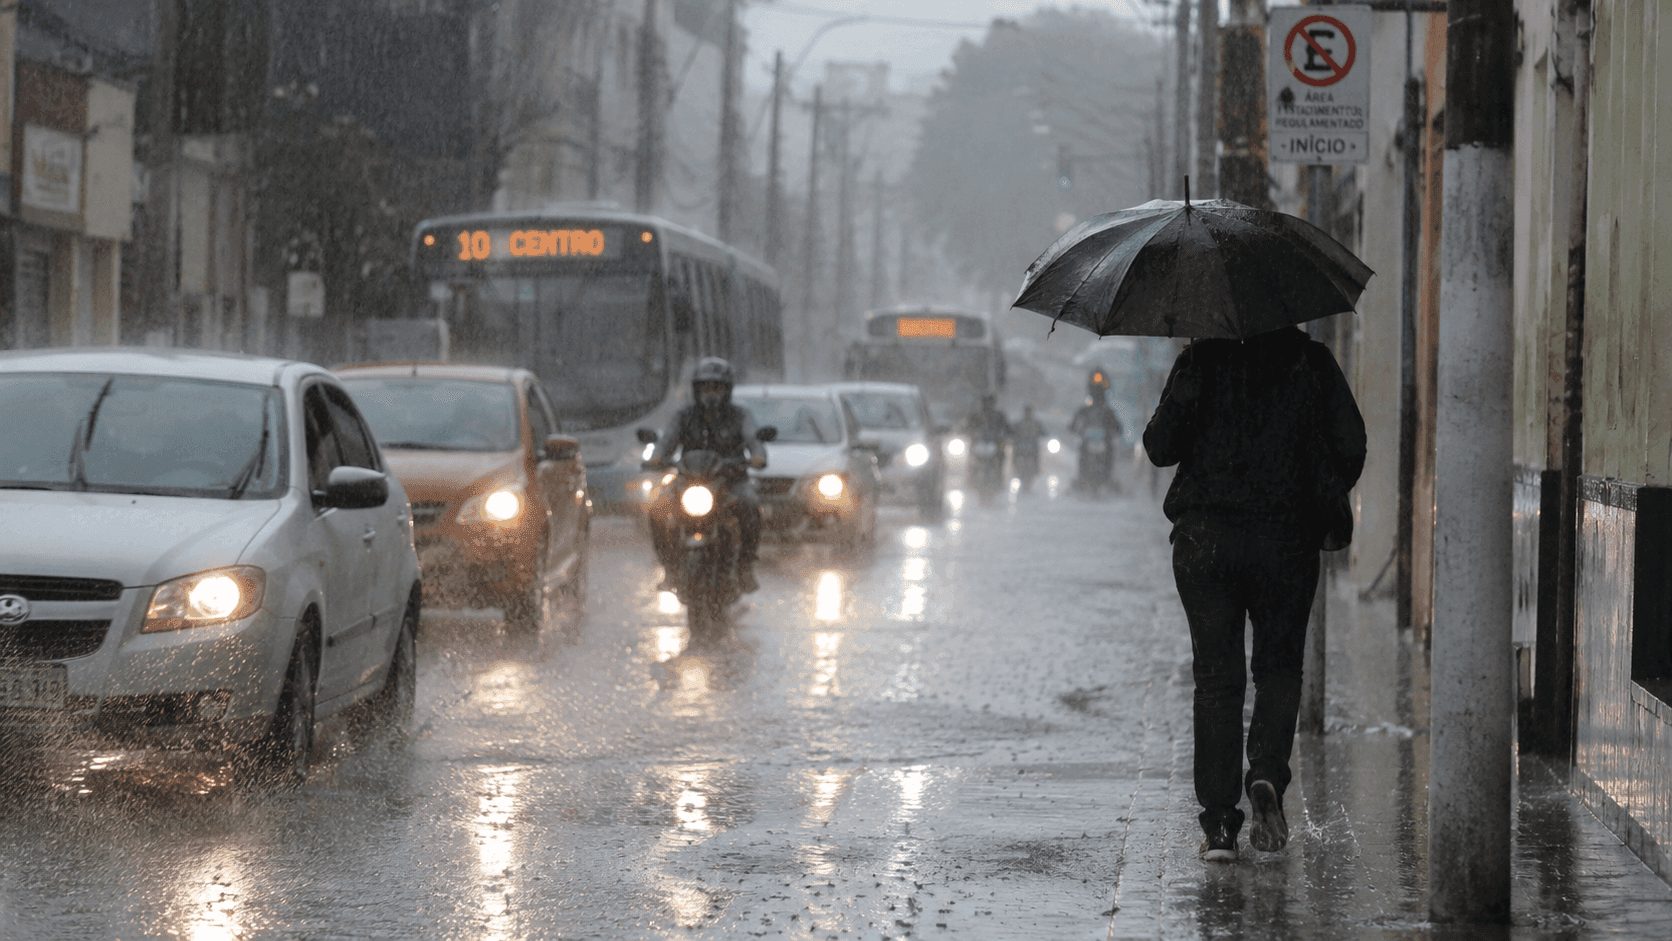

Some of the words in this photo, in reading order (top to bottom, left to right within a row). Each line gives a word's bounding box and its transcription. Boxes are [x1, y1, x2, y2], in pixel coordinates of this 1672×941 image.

[1305, 89, 1334, 102] ÁREA
[1290, 134, 1345, 154] INÍCIO
[457, 230, 490, 260] 10
[510, 229, 604, 256] CENTRO
